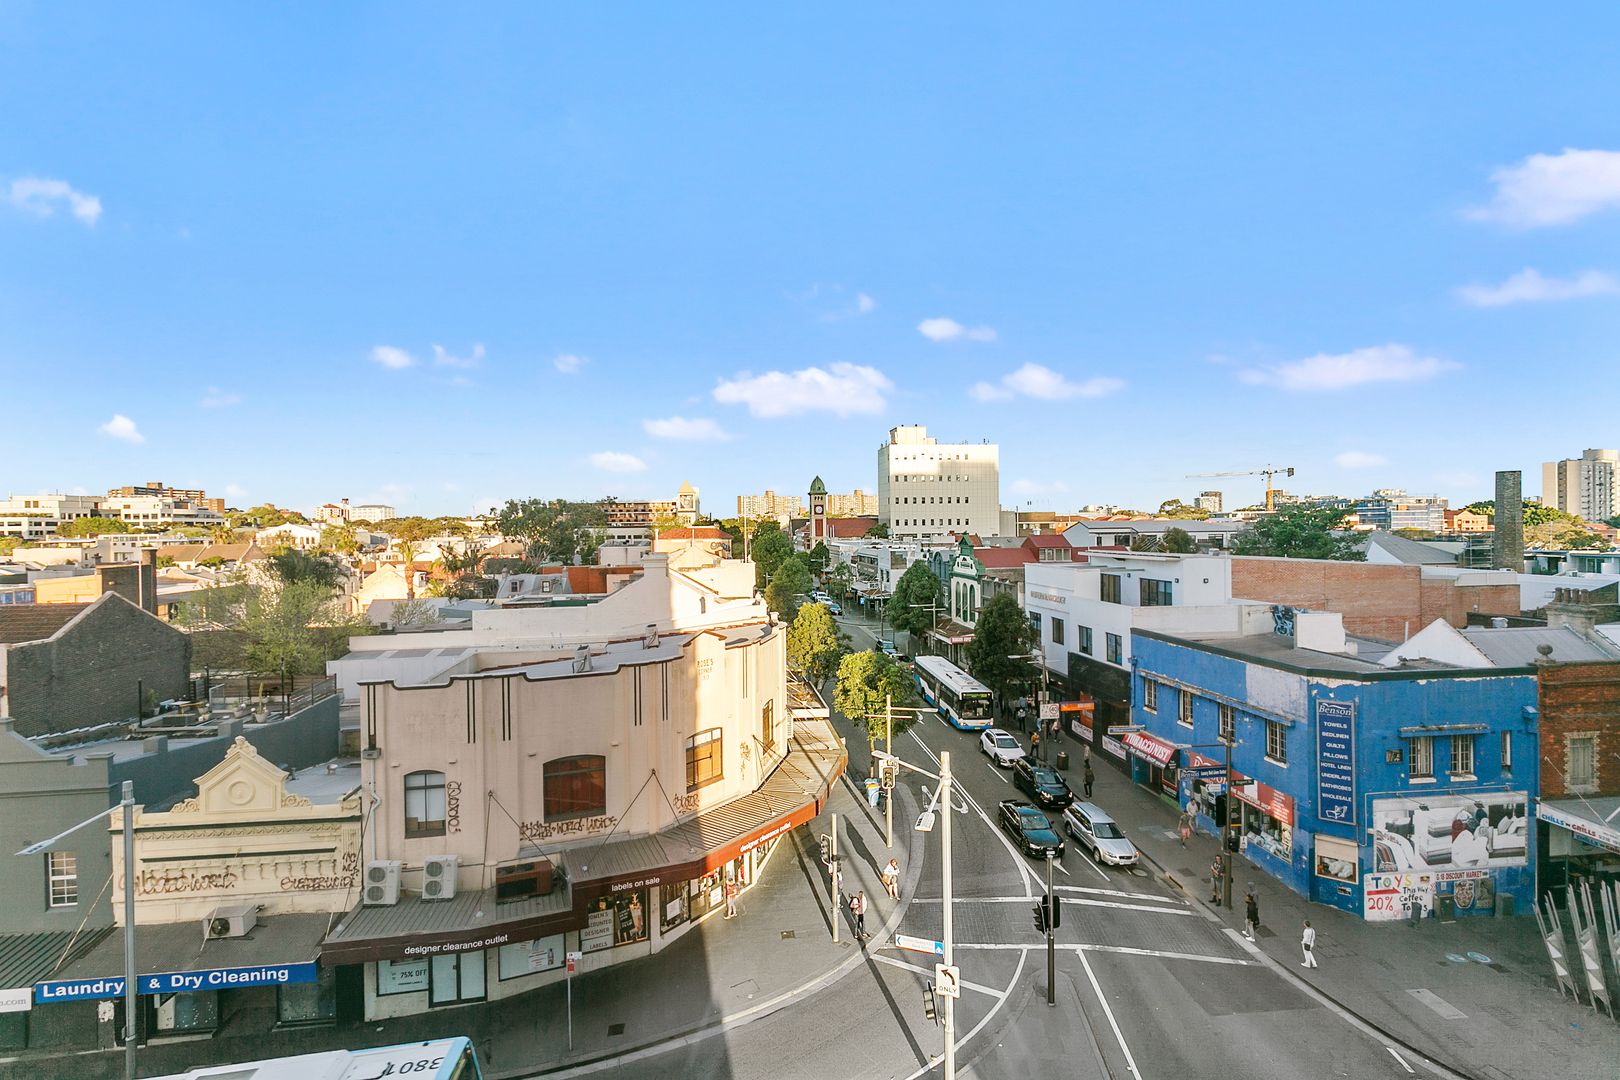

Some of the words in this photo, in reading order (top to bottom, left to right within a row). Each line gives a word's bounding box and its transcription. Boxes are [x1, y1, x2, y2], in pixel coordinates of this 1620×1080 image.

[1319, 704, 1352, 716] Benson
[1126, 733, 1169, 760] TOBACCONIST
[1323, 752, 1348, 760] PILLOWS
[1321, 792, 1352, 802] WHOLESALE
[1446, 872, 1465, 880] DISCOUNT
[611, 881, 633, 892] labels
[634, 880, 644, 888] on
[645, 877, 660, 885] sale
[1368, 896, 1393, 911] 20%
[584, 927, 610, 936] DESIGNER
[404, 944, 441, 954] designer
[442, 940, 483, 951] clearance
[484, 934, 508, 945] outlet
[590, 941, 608, 950] LABELS
[415, 969, 427, 977] OFF
[43, 981, 124, 998] Laundry
[149, 978, 161, 989] &
[171, 974, 203, 989] Dry
[208, 968, 289, 984] Cleaning
[938, 985, 958, 994] ONLY
[0, 998, 26, 1007] .com
